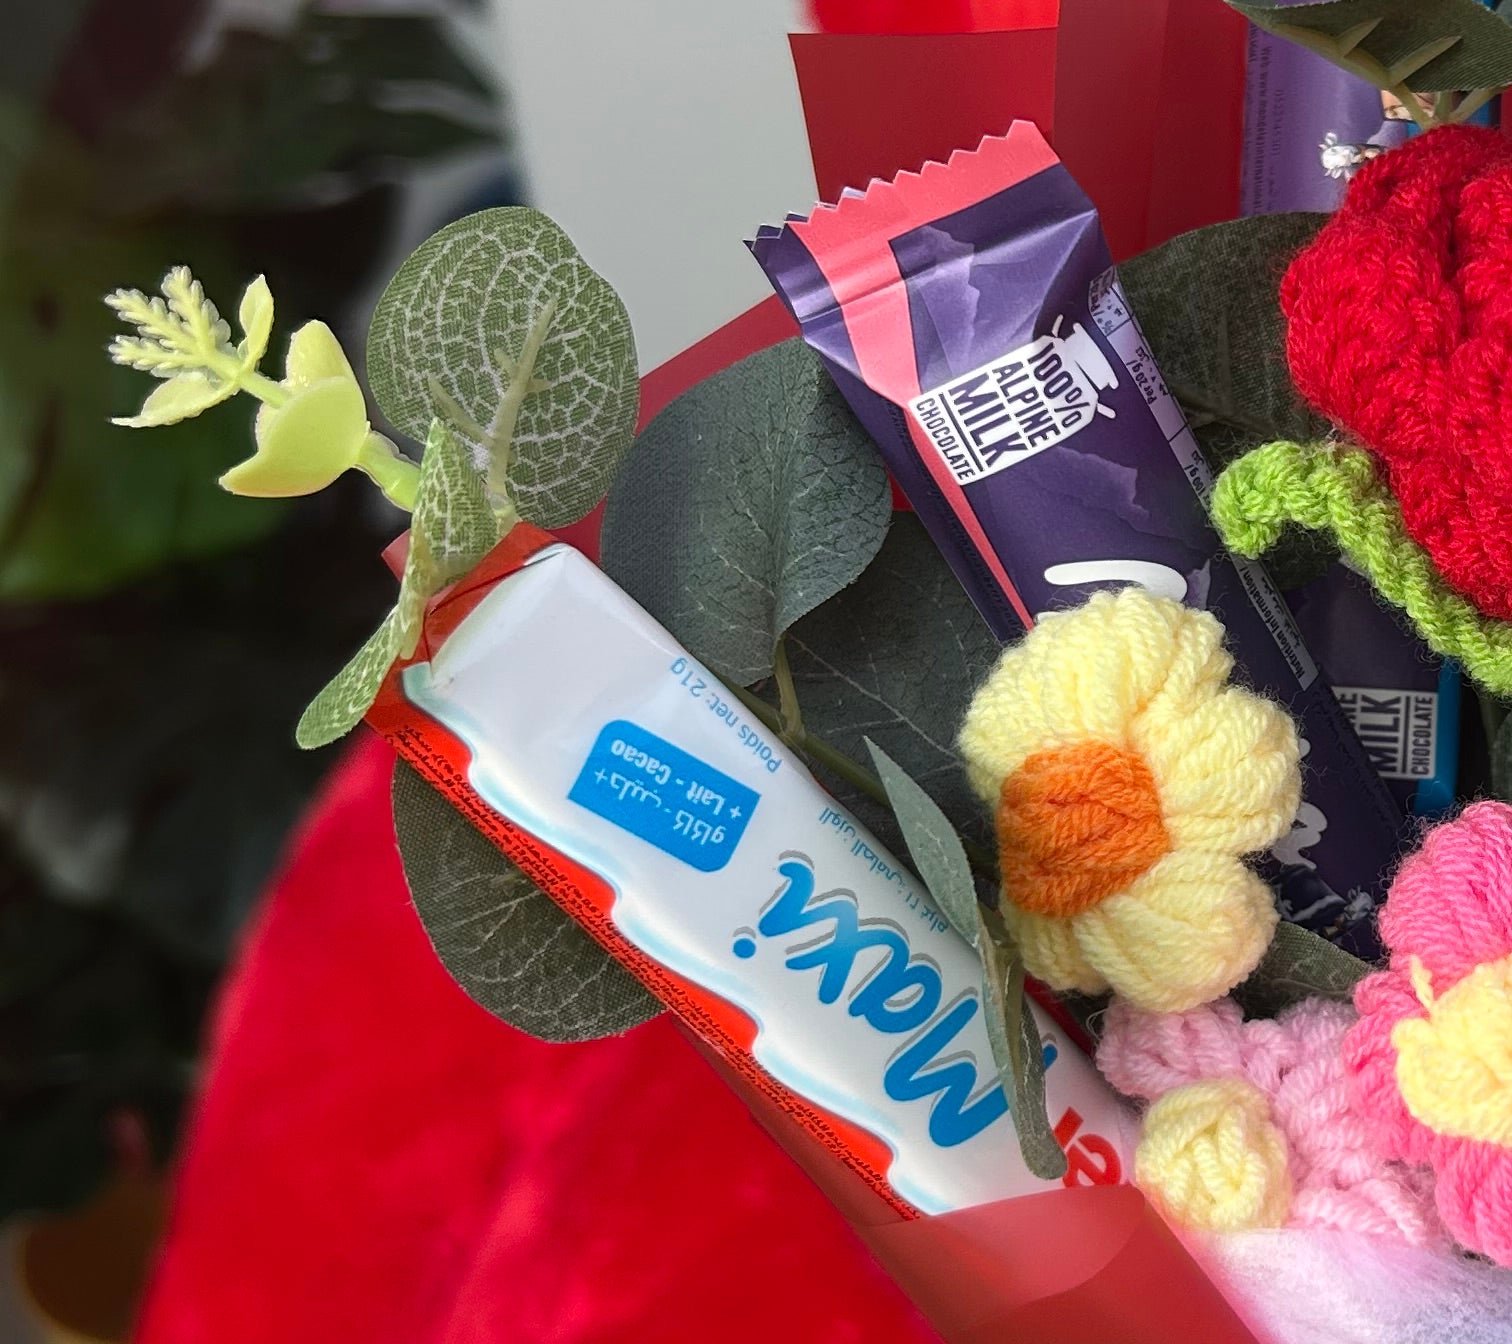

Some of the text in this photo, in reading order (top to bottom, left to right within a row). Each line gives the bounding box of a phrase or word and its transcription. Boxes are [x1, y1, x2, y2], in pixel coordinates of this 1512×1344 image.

[948, 372, 1028, 467] MILK
[992, 361, 1061, 448] ALPINE
[1027, 341, 1091, 428] 100%
[916, 397, 976, 481] CHOCOLATE
[1240, 571, 1281, 632] Information
[1273, 630, 1306, 678] Nutrition
[669, 656, 783, 774] Poids net: 21g
[1359, 694, 1402, 773] MILK
[1411, 695, 1434, 775] CHOCOLATE
[610, 739, 672, 786] Cacao
[685, 780, 727, 816] Lait
[672, 810, 727, 846] كاكاو
[818, 807, 857, 842] الوزن
[921, 904, 949, 934] غرام
[733, 859, 1058, 1148] Maxi
